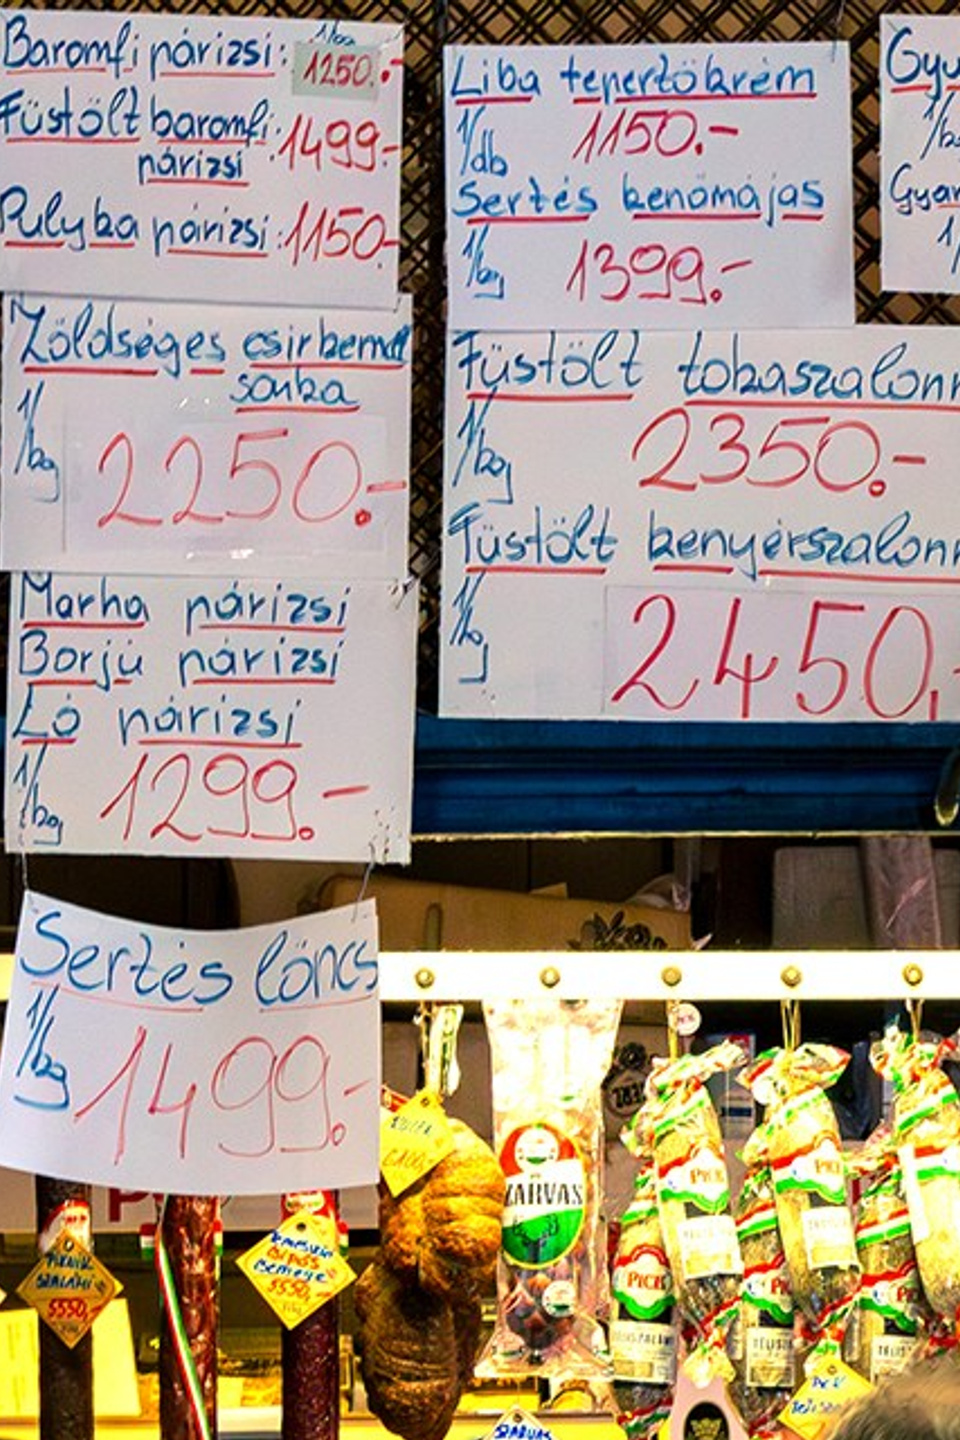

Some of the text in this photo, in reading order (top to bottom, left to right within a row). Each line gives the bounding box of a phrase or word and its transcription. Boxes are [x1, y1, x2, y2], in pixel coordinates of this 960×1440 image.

[3, 14, 138, 78] Baromfi
[451, 55, 540, 97] Liba
[0, 84, 140, 138] Füstölt
[572, 109, 738, 163] 1150.-
[138, 148, 244, 185] párizsi
[451, 176, 598, 217] Sertés
[0, 184, 138, 251] Pulyka
[566, 240, 752, 305] 1399.-
[10, 300, 225, 377] Zöldséges
[451, 330, 643, 389] Füstölt
[230, 370, 358, 404] sonka
[98, 428, 407, 527] 2250.-
[632, 407, 926, 495] 2350.-
[448, 502, 619, 566] Füstölt
[20, 572, 350, 636] Marha párizsi
[18, 628, 344, 690] Borjú párizsi
[12, 683, 302, 746] Ló párizsi
[100, 753, 369, 841] 1299.-
[20, 911, 378, 1006] Sertés löncs
[74, 1025, 369, 1166] 1499.-
